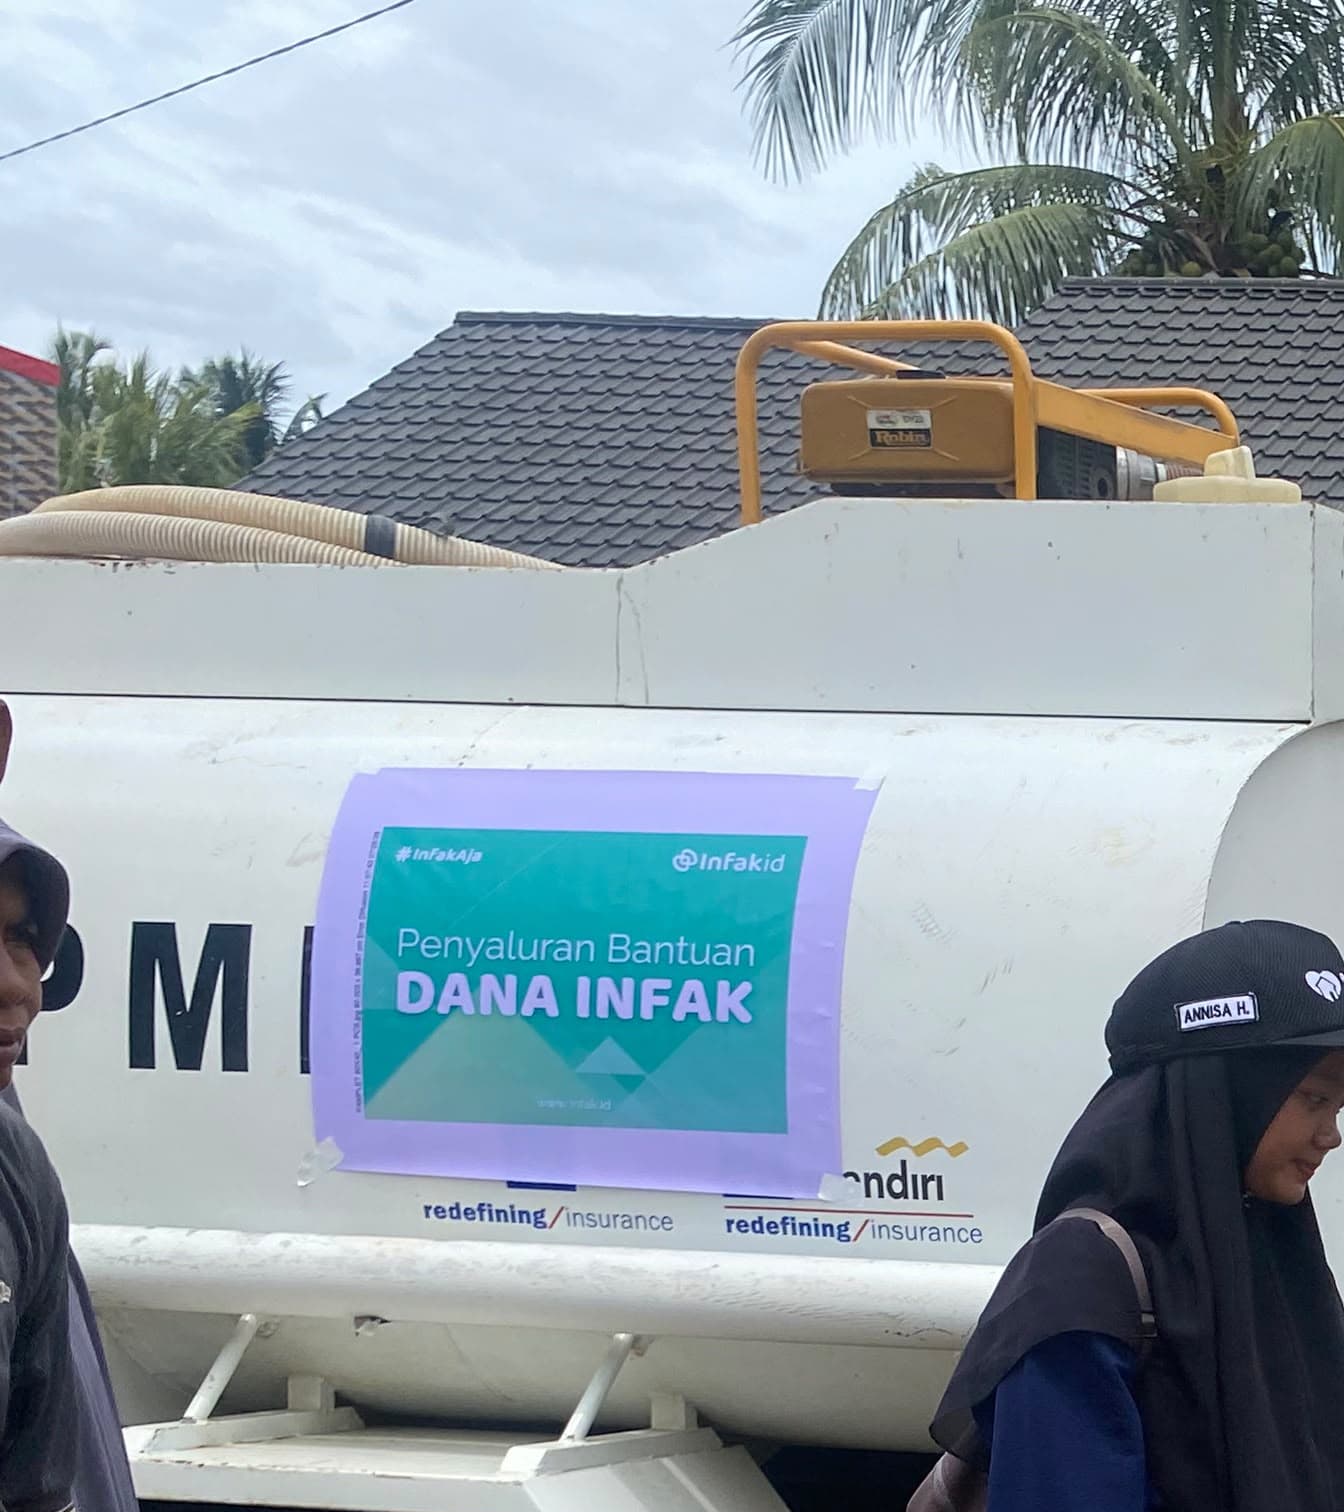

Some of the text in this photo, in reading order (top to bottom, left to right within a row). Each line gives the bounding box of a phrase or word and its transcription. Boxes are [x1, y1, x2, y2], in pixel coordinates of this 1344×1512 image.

[397, 928, 756, 967] Penyaluran Bantuan
[395, 971, 754, 1024] DANA INFAK
[1184, 1001, 1251, 1024] ANNISA H.
